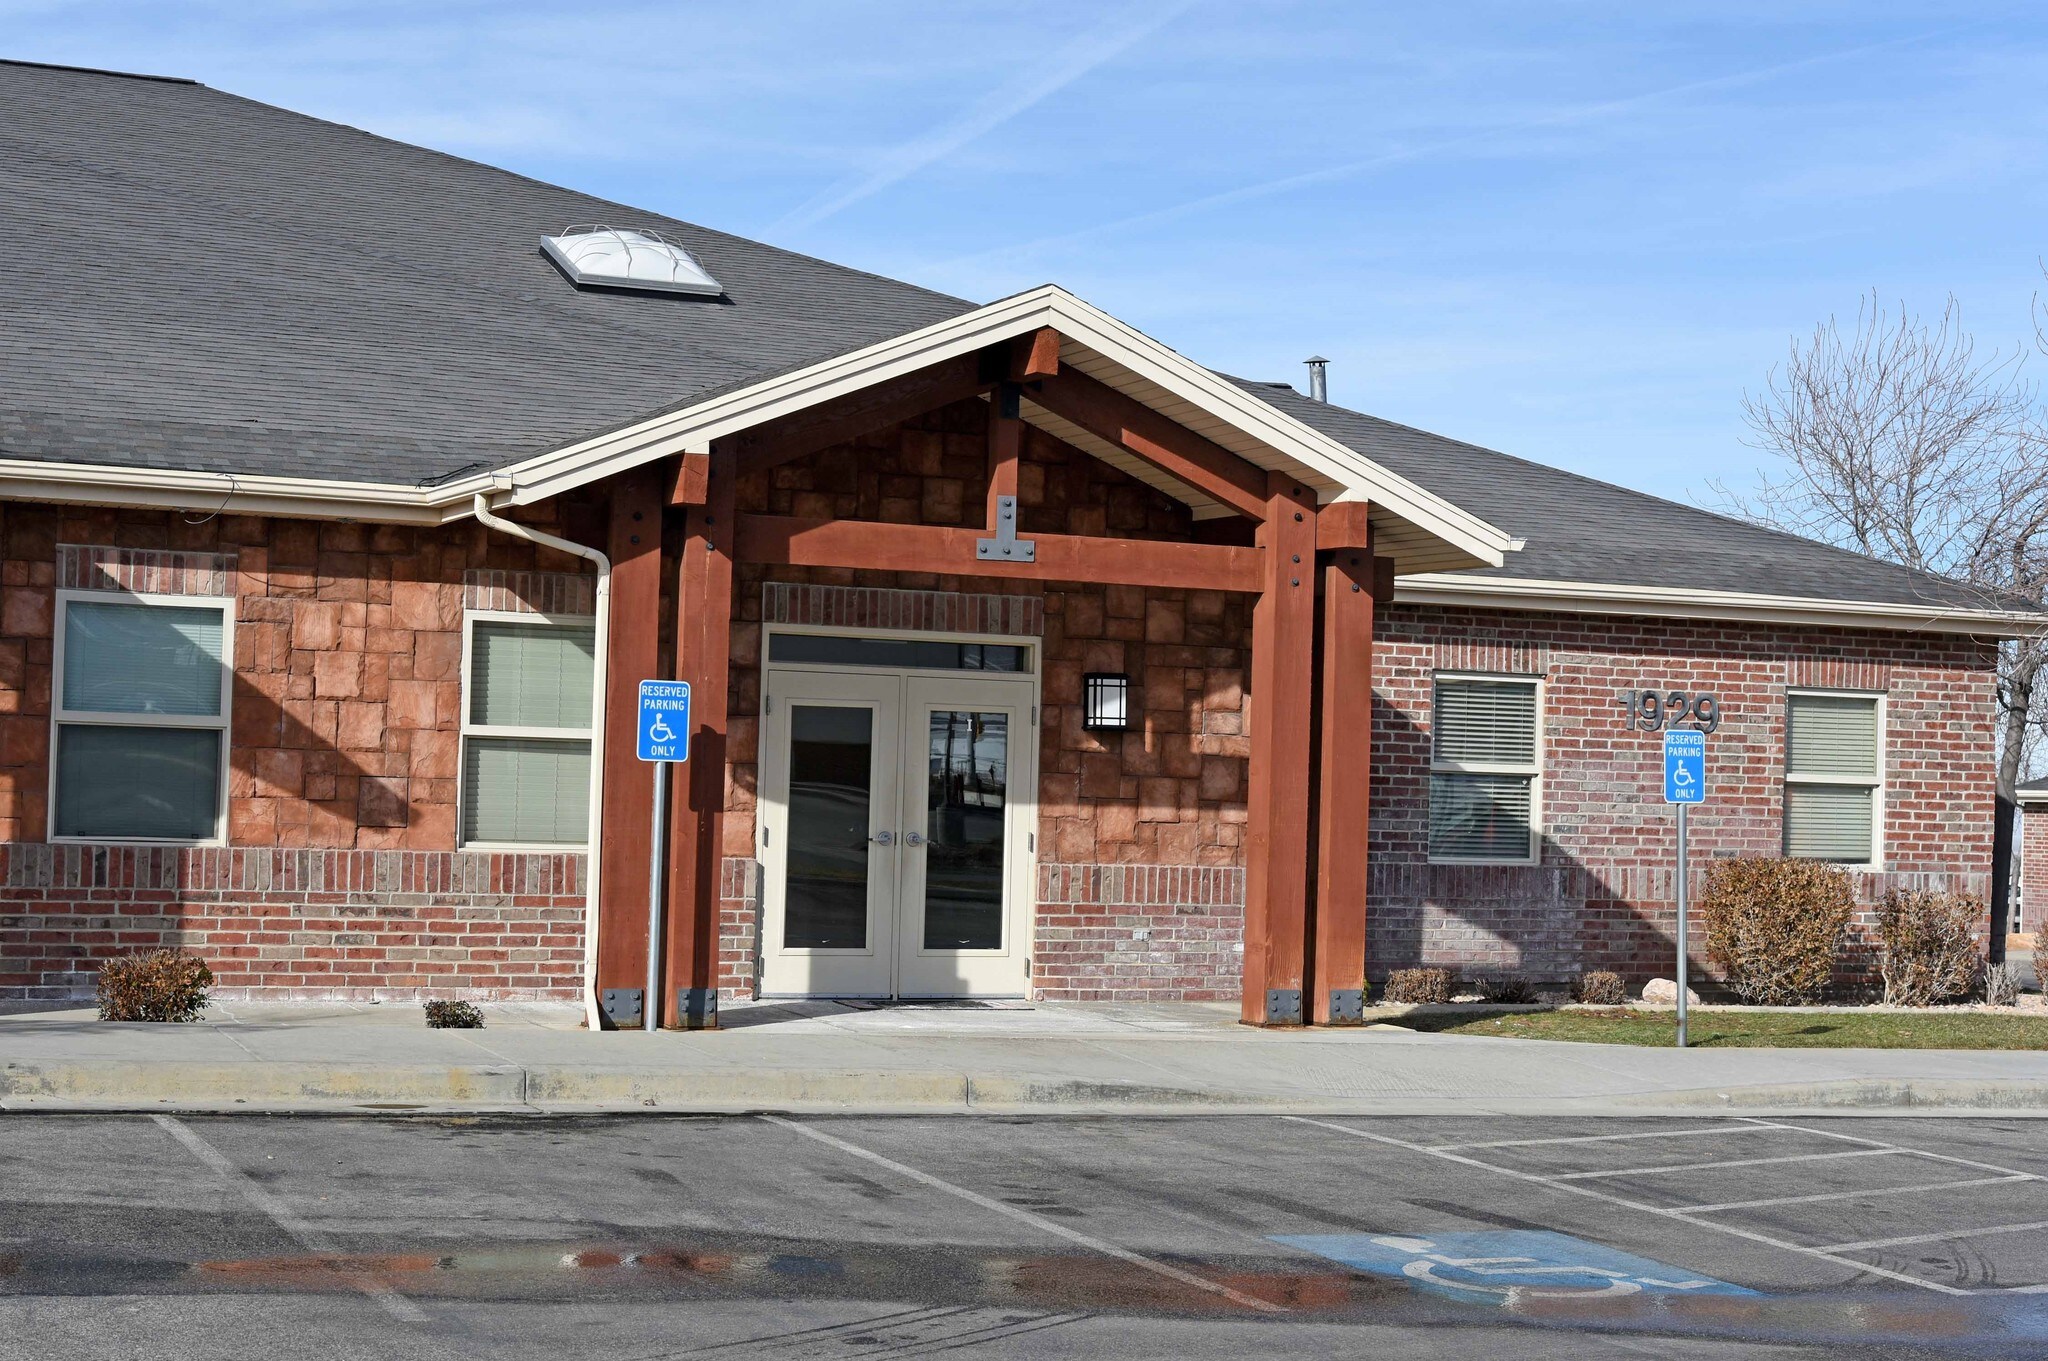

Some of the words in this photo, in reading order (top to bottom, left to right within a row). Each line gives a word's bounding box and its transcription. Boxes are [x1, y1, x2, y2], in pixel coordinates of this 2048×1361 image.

[641, 685, 688, 698] RESERVED
[644, 699, 685, 711] PARKING
[1618, 690, 1720, 734] 1929
[1666, 734, 1703, 745] RESERVED
[650, 745, 676, 756] ONLY
[1668, 747, 1701, 757] PARKING
[1675, 788, 1696, 798] ONLY
